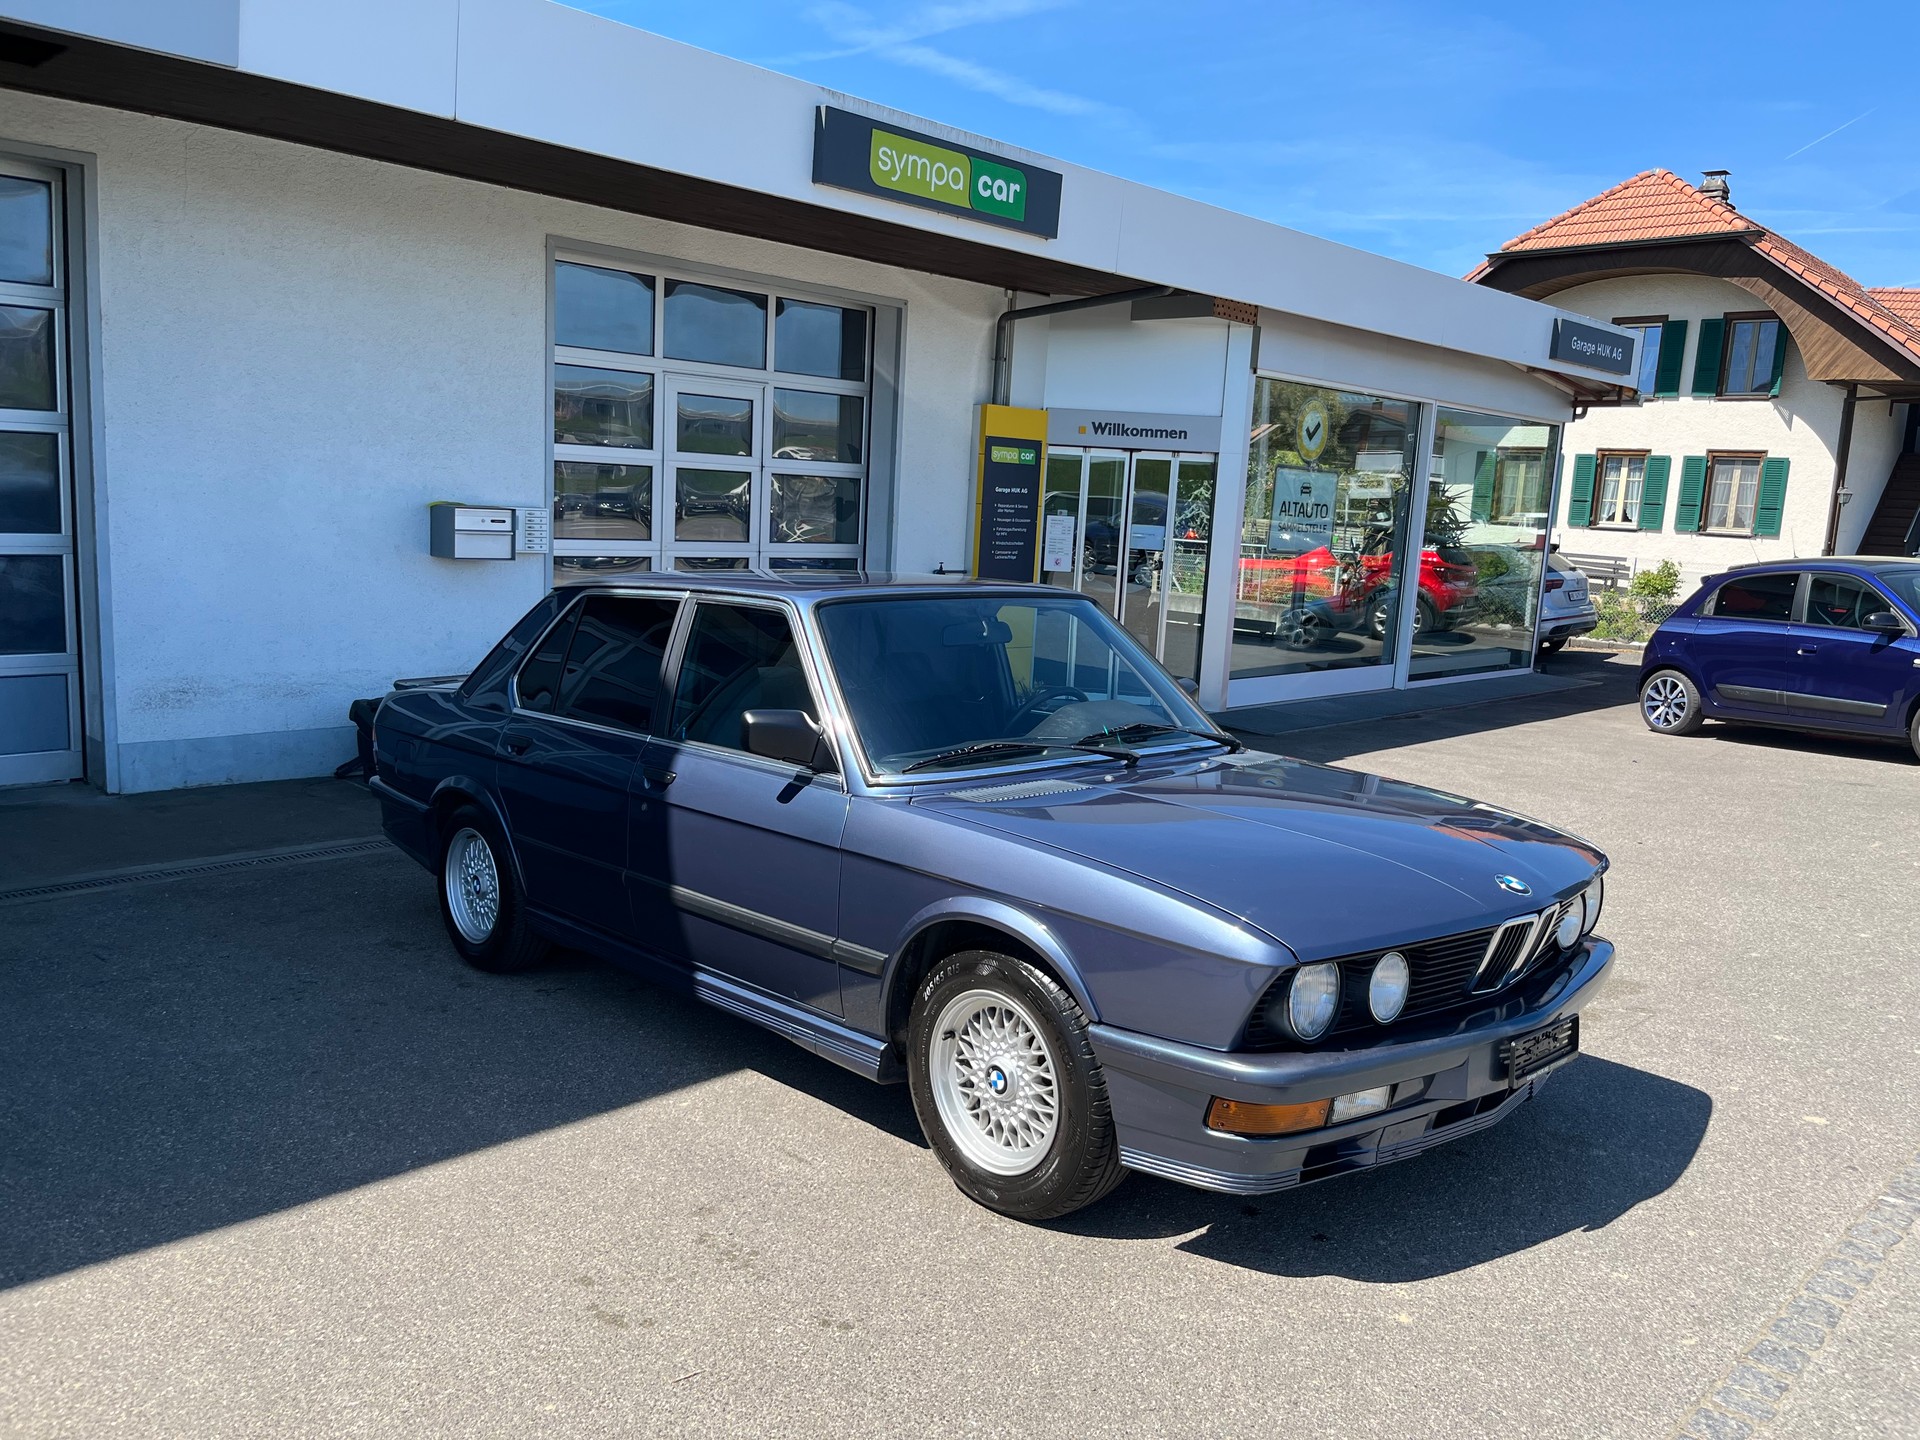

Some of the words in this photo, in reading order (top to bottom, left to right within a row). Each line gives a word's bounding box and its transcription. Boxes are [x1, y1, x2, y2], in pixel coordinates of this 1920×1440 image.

[877, 146, 964, 192] sympa
[977, 175, 1020, 204] car
[1571, 336, 1596, 355] Garage
[1596, 342, 1612, 358] HUK
[1612, 347, 1622, 360] AG
[1091, 421, 1188, 440] Willkommen
[993, 450, 1018, 461] sympa
[1020, 452, 1034, 460] car
[995, 486, 1010, 494] Garage
[1278, 500, 1329, 519] ALTAUTO
[1277, 522, 1328, 534] SAMMELSTELLE
[946, 963, 960, 977] R15
